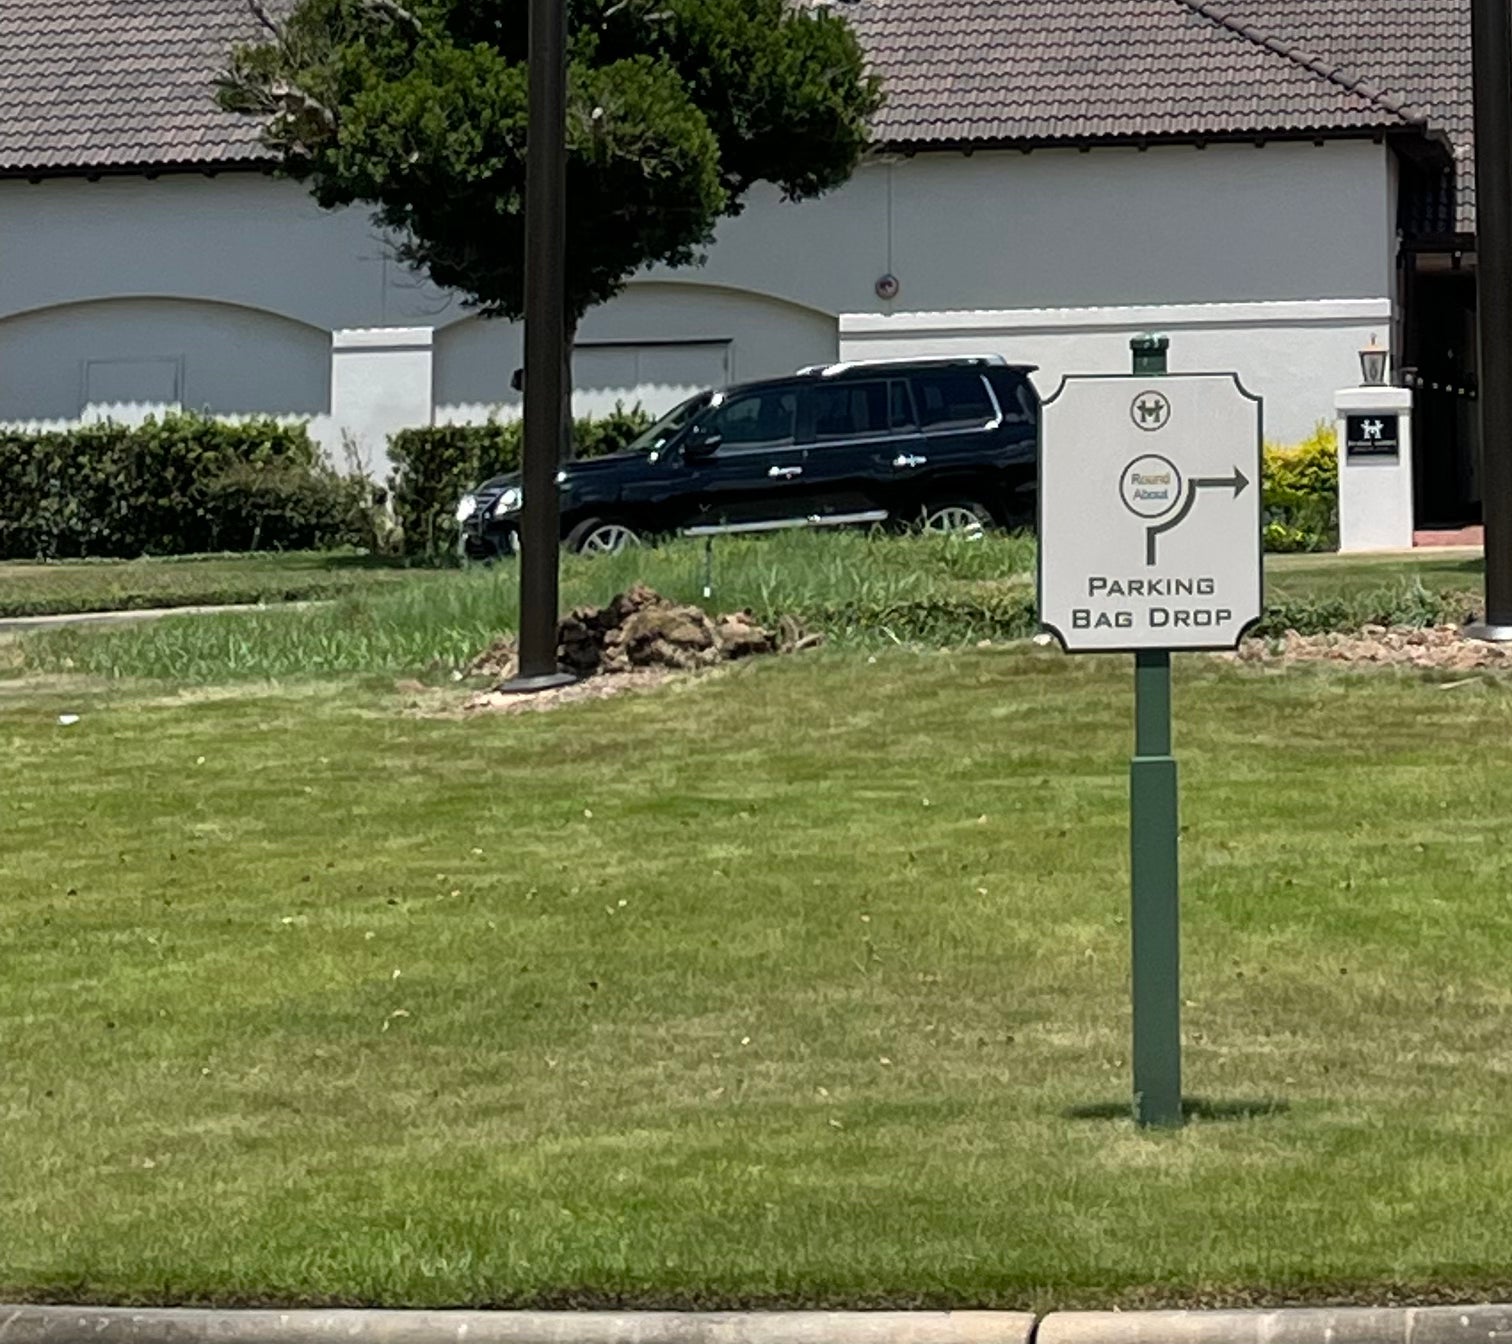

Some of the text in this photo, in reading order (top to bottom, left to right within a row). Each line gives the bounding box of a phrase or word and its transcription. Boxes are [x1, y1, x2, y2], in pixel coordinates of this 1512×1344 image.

[1088, 577, 1214, 597] PARKING
[1072, 607, 1232, 629] BAG DROP
